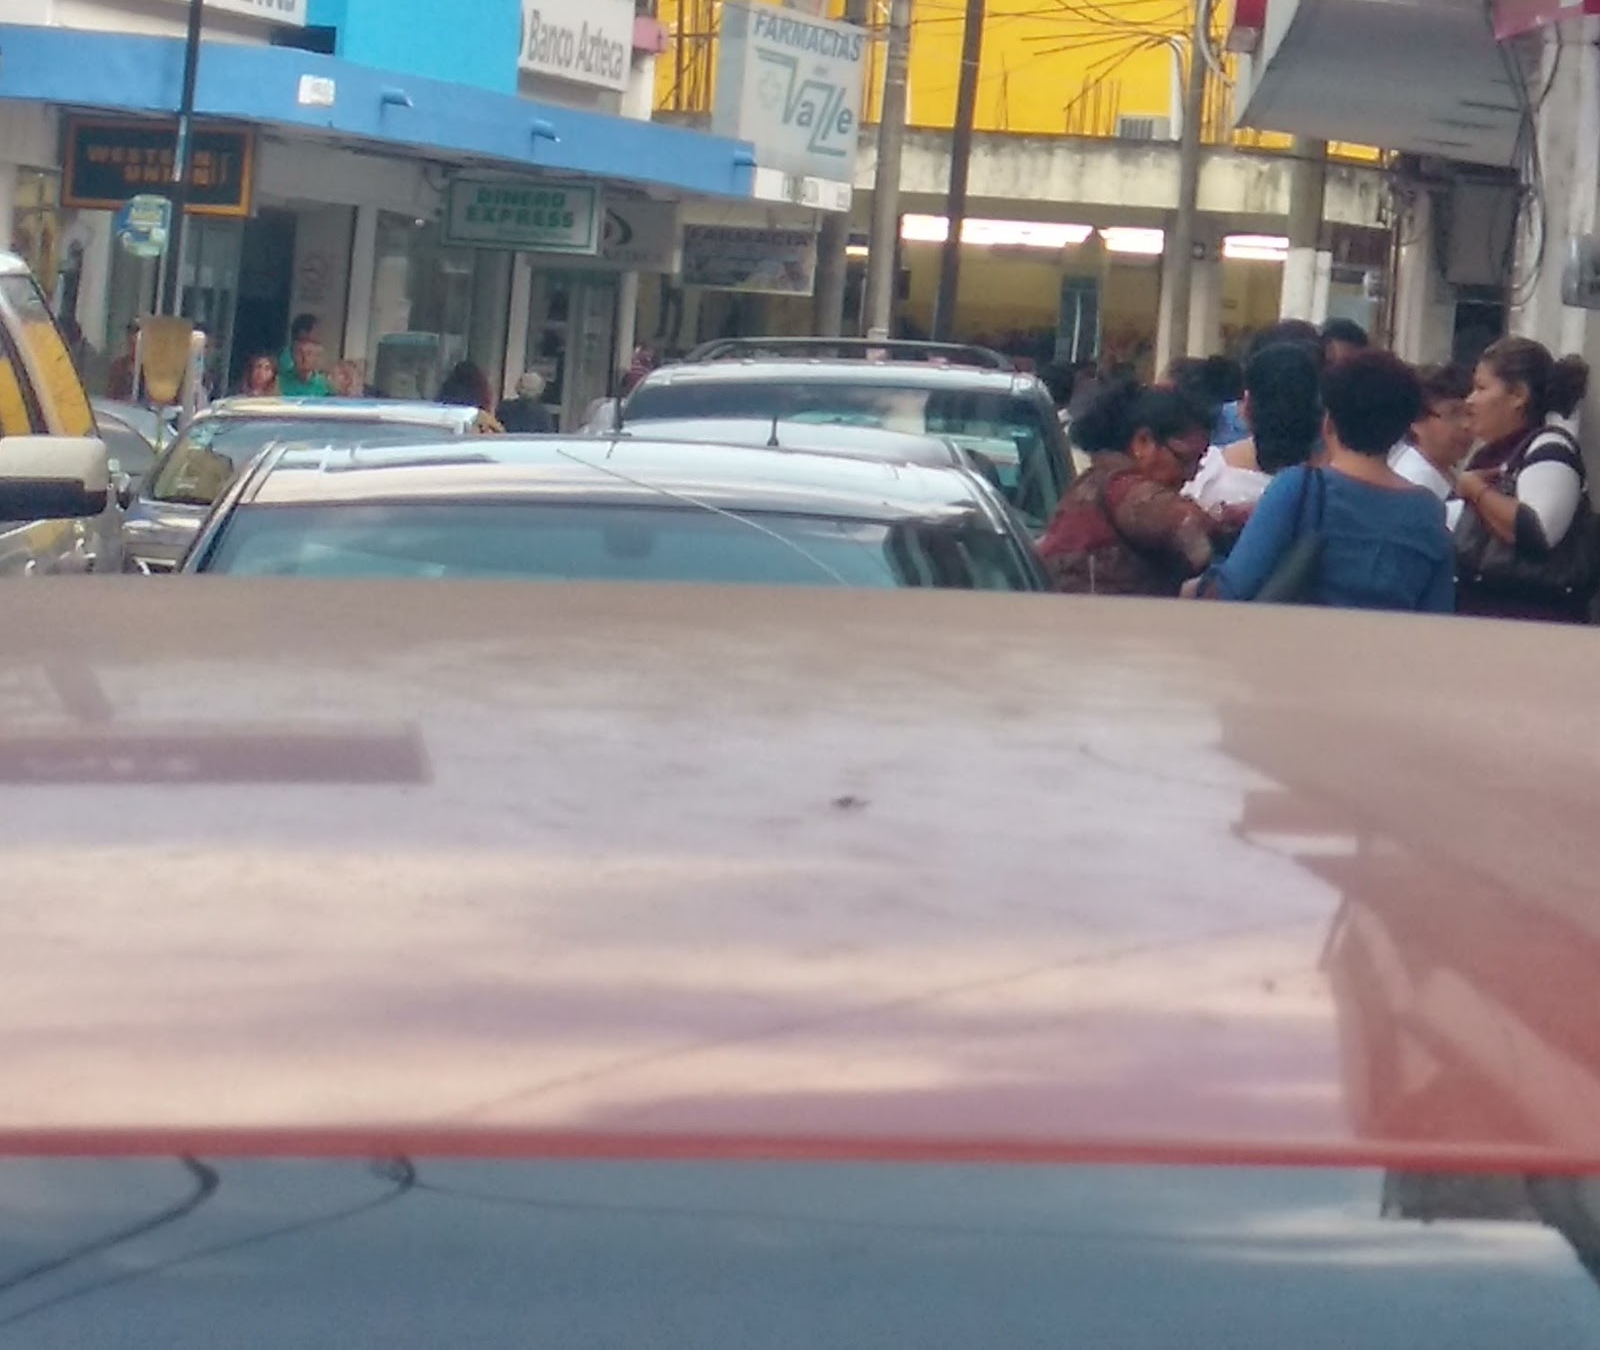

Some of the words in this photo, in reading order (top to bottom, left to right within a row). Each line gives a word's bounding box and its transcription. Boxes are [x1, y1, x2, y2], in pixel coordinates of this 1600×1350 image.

[528, 9, 574, 69] Banco
[575, 20, 624, 81] Azteca
[754, 12, 862, 62] FARMACIAS
